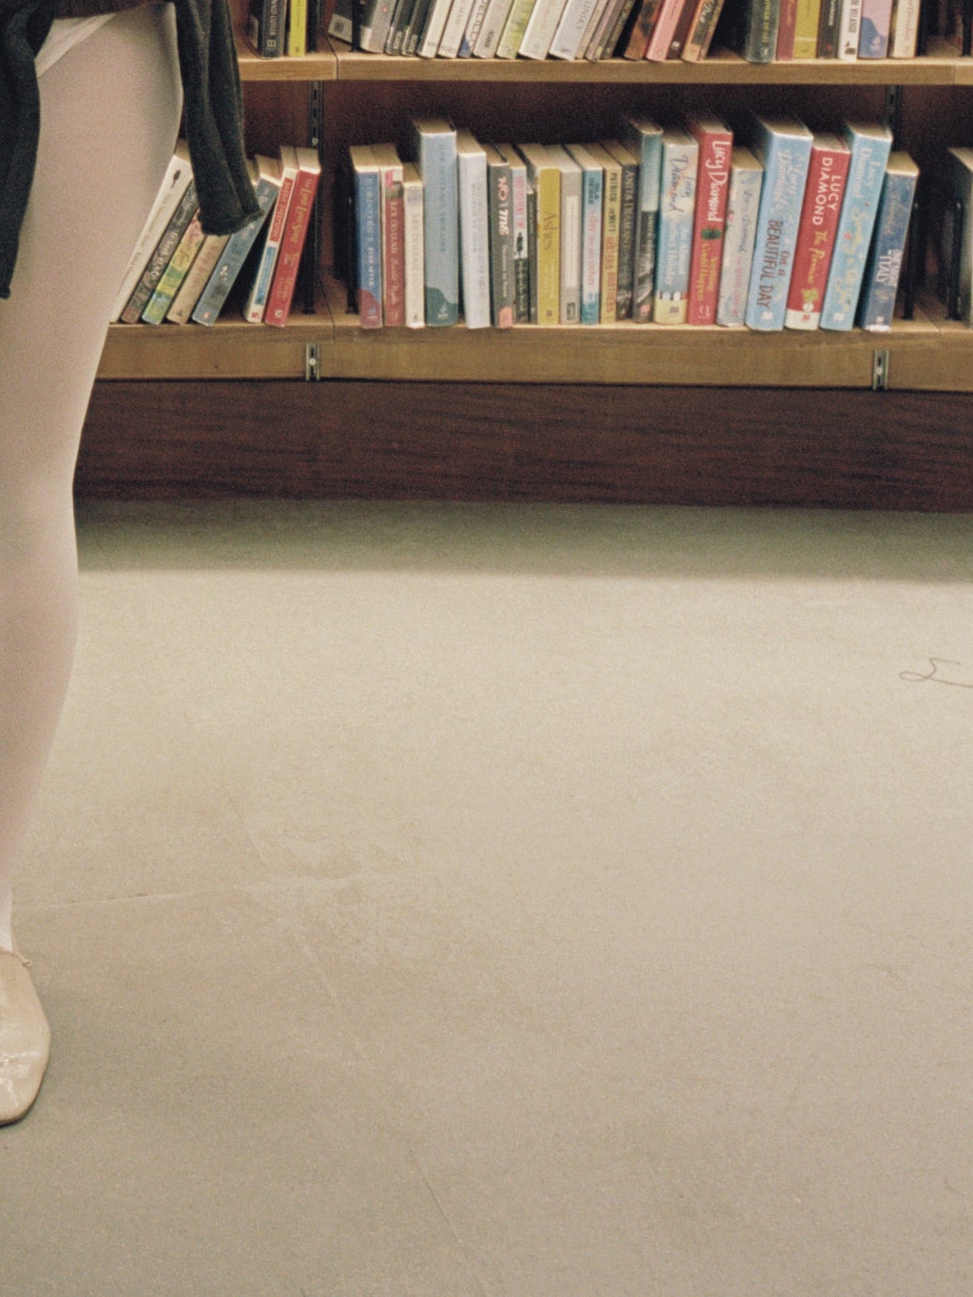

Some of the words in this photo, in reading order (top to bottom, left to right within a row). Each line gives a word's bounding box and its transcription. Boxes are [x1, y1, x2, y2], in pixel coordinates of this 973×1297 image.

[705, 141, 731, 169] Lucy
[609, 172, 618, 203] PATRICK
[668, 155, 688, 213] Diamond
[707, 172, 726, 222] Diamond
[812, 157, 832, 226] DIAMOND
[828, 175, 842, 211] LUCY
[544, 210, 556, 251] Ashes
[814, 230, 828, 245] The
[760, 219, 784, 281] BEAUTIFUL
[756, 284, 774, 310] DAY
